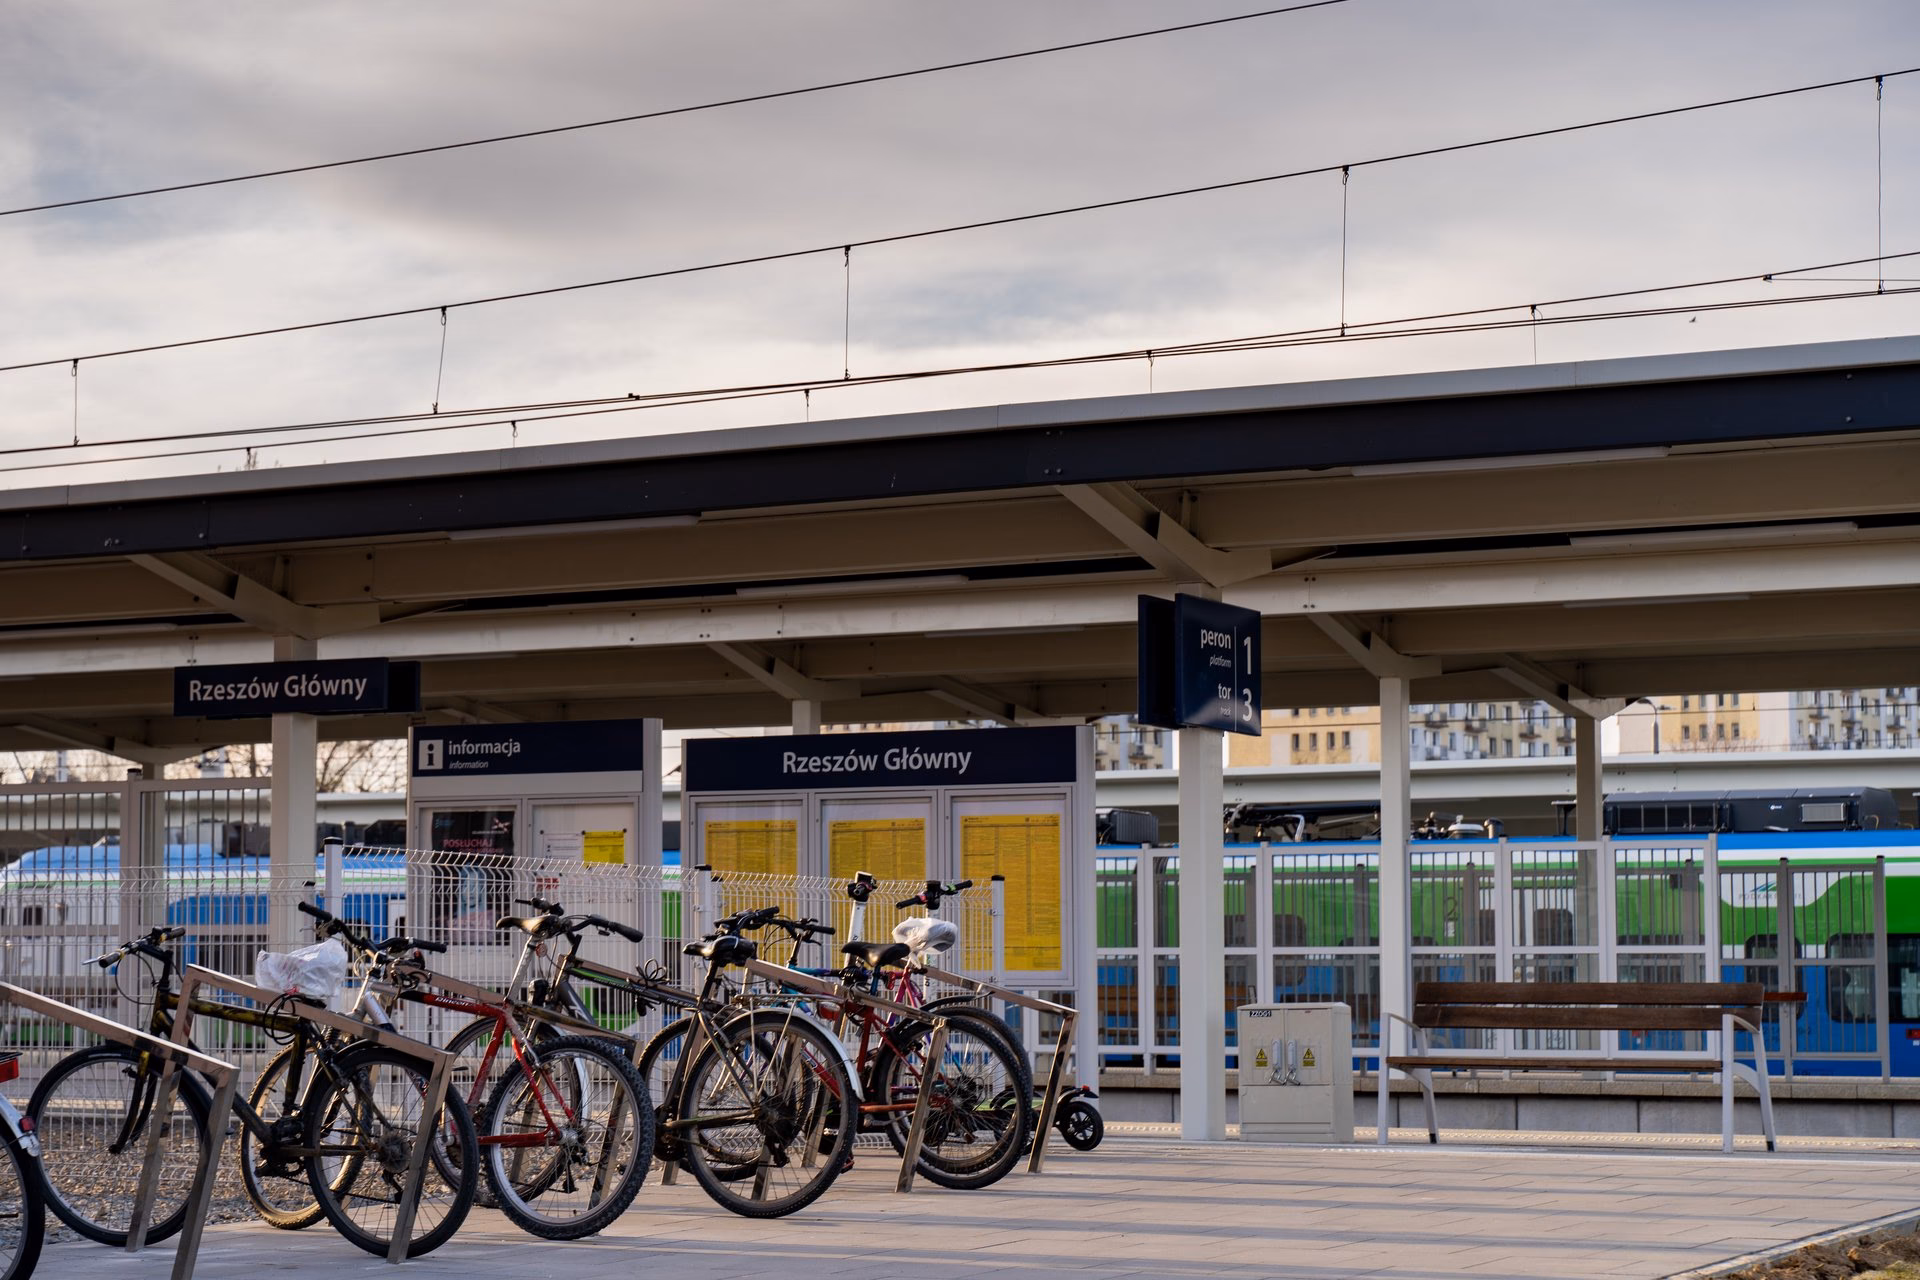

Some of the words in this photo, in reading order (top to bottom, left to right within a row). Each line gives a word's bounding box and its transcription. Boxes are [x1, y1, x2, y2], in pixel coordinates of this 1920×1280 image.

[1201, 629, 1231, 649] peron
[1243, 636, 1252, 675] 1
[1209, 654, 1231, 668] platform
[189, 676, 279, 702] Rzeszów
[284, 673, 367, 701] Główny
[1218, 683, 1231, 700] tor
[1242, 688, 1252, 722] 3
[1220, 706, 1231, 717] track
[448, 738, 521, 758] informacja
[449, 760, 489, 770] information
[783, 749, 878, 774] Rzeszów
[883, 747, 972, 775] Główny
